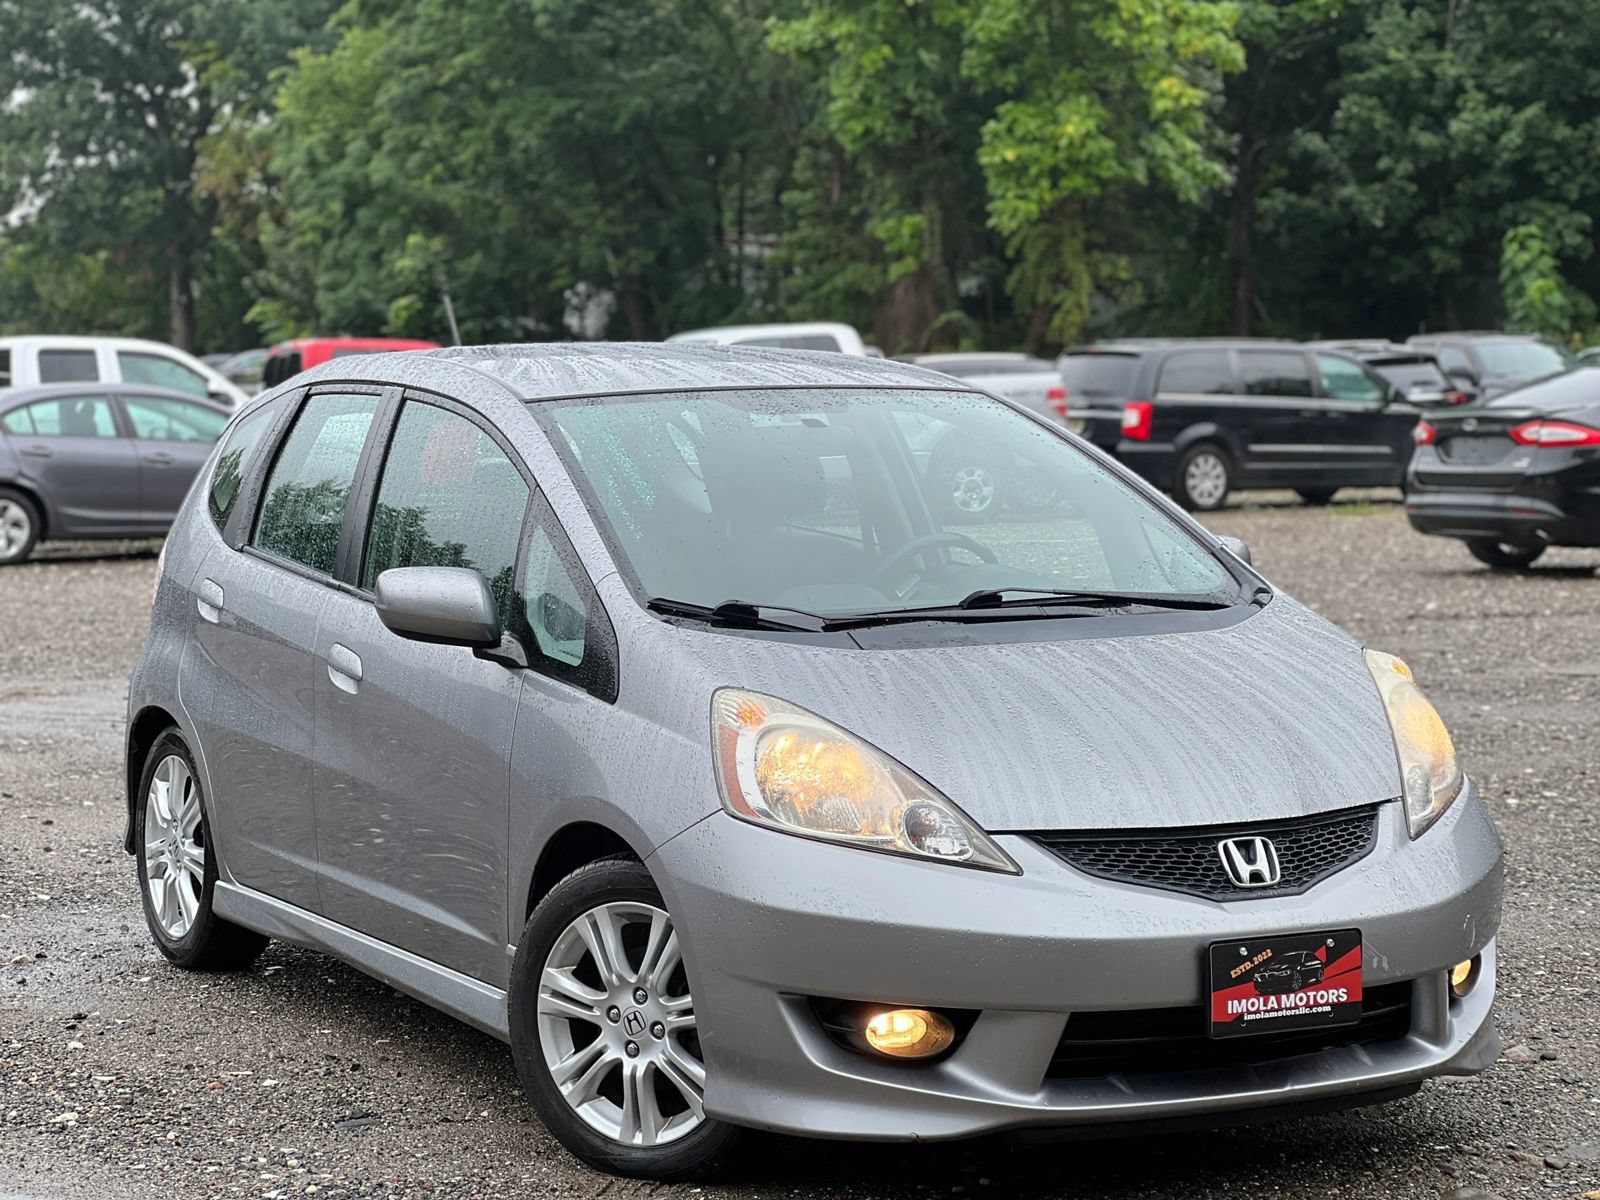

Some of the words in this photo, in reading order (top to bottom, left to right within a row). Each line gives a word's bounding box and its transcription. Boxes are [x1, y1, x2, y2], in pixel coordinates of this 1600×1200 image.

[1227, 995, 1278, 1014] IMOLA
[1281, 988, 1348, 1009] MOTORS
[1243, 1005, 1332, 1021] imolamotorsllc.com
